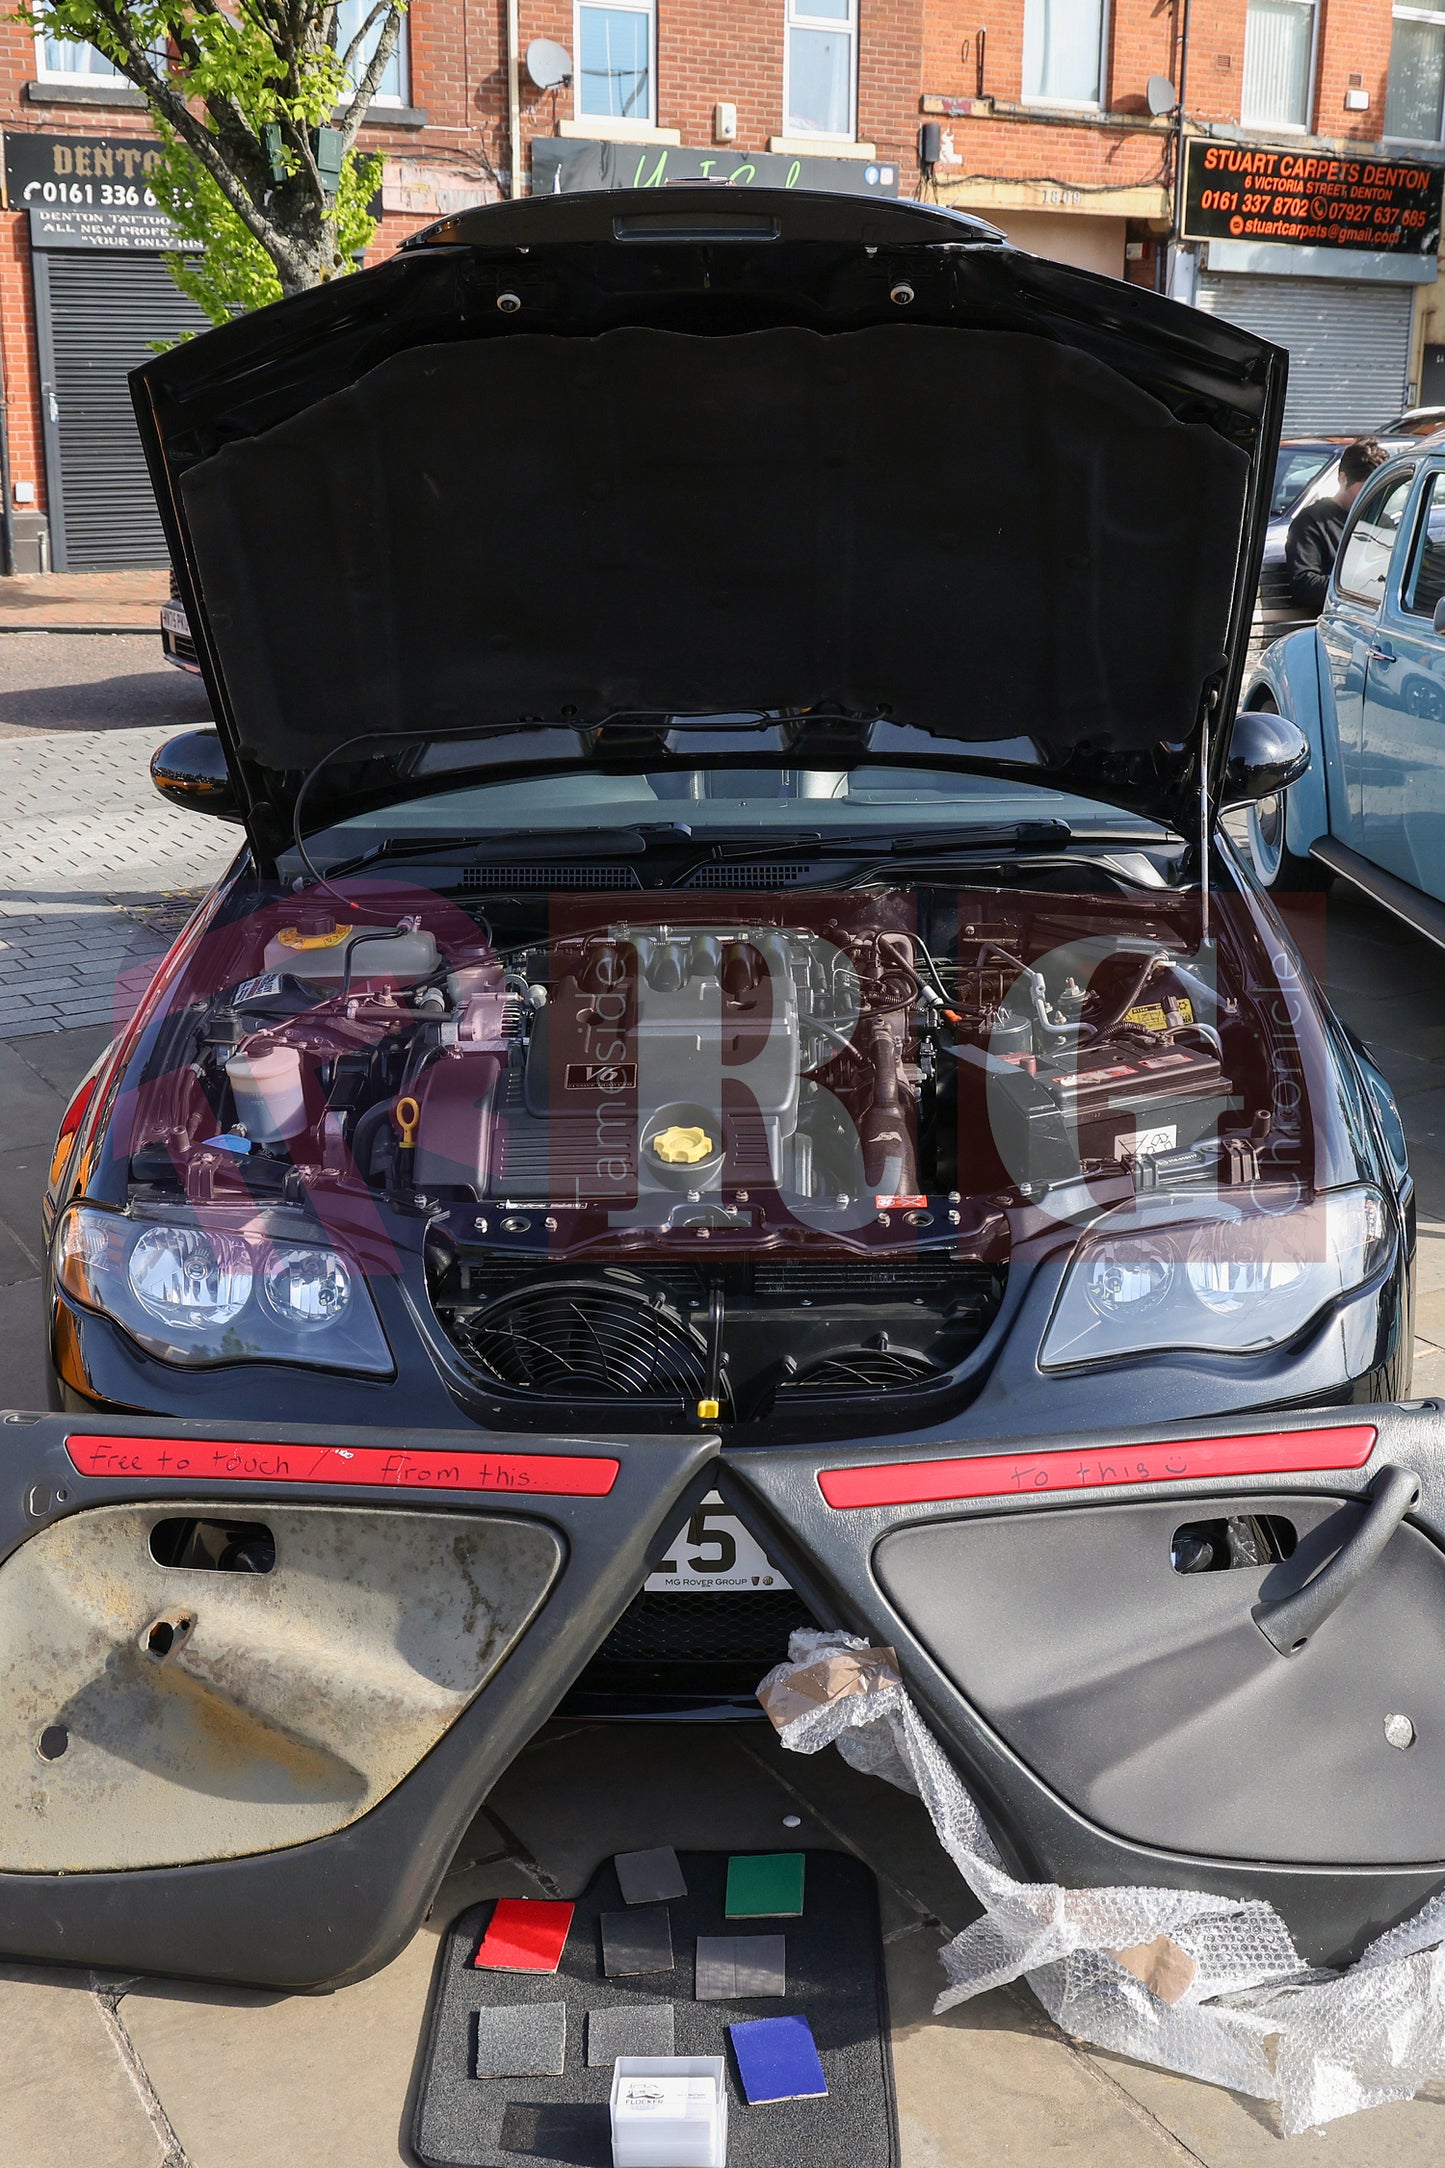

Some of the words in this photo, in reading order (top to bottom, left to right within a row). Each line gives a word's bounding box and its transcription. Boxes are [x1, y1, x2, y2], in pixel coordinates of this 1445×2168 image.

[1204, 147, 1278, 175] STUART
[1280, 156, 1361, 183] CARPETS
[1363, 165, 1431, 190] DENTON
[43, 182, 93, 204] 0161
[101, 184, 139, 206] 336
[1244, 175, 1253, 189] 6
[1254, 176, 1304, 194] VICTORIA
[1350, 186, 1393, 201] DENTON
[40, 211, 104, 223] DENTON
[108, 213, 171, 226] TATTOO
[1201, 190, 1239, 211] 0161
[1242, 193, 1272, 214] 337
[1272, 197, 1309, 217] 8702
[1328, 202, 1373, 222] 07927
[1374, 207, 1400, 224] 637
[1401, 209, 1428, 228] 685
[43, 223, 76, 233] ALL
[81, 224, 116, 235] NEW
[1245, 217, 1400, 244] stuartcarpets@gmail.com
[134, 237, 174, 248] ONLY
[586, 1065, 622, 1082] V6
[158, 1450, 190, 1472] to
[212, 1450, 289, 1475] touch
[1011, 1466, 1048, 1489] to
[1077, 1462, 1150, 1485] this
[665, 1578, 681, 1586] MG
